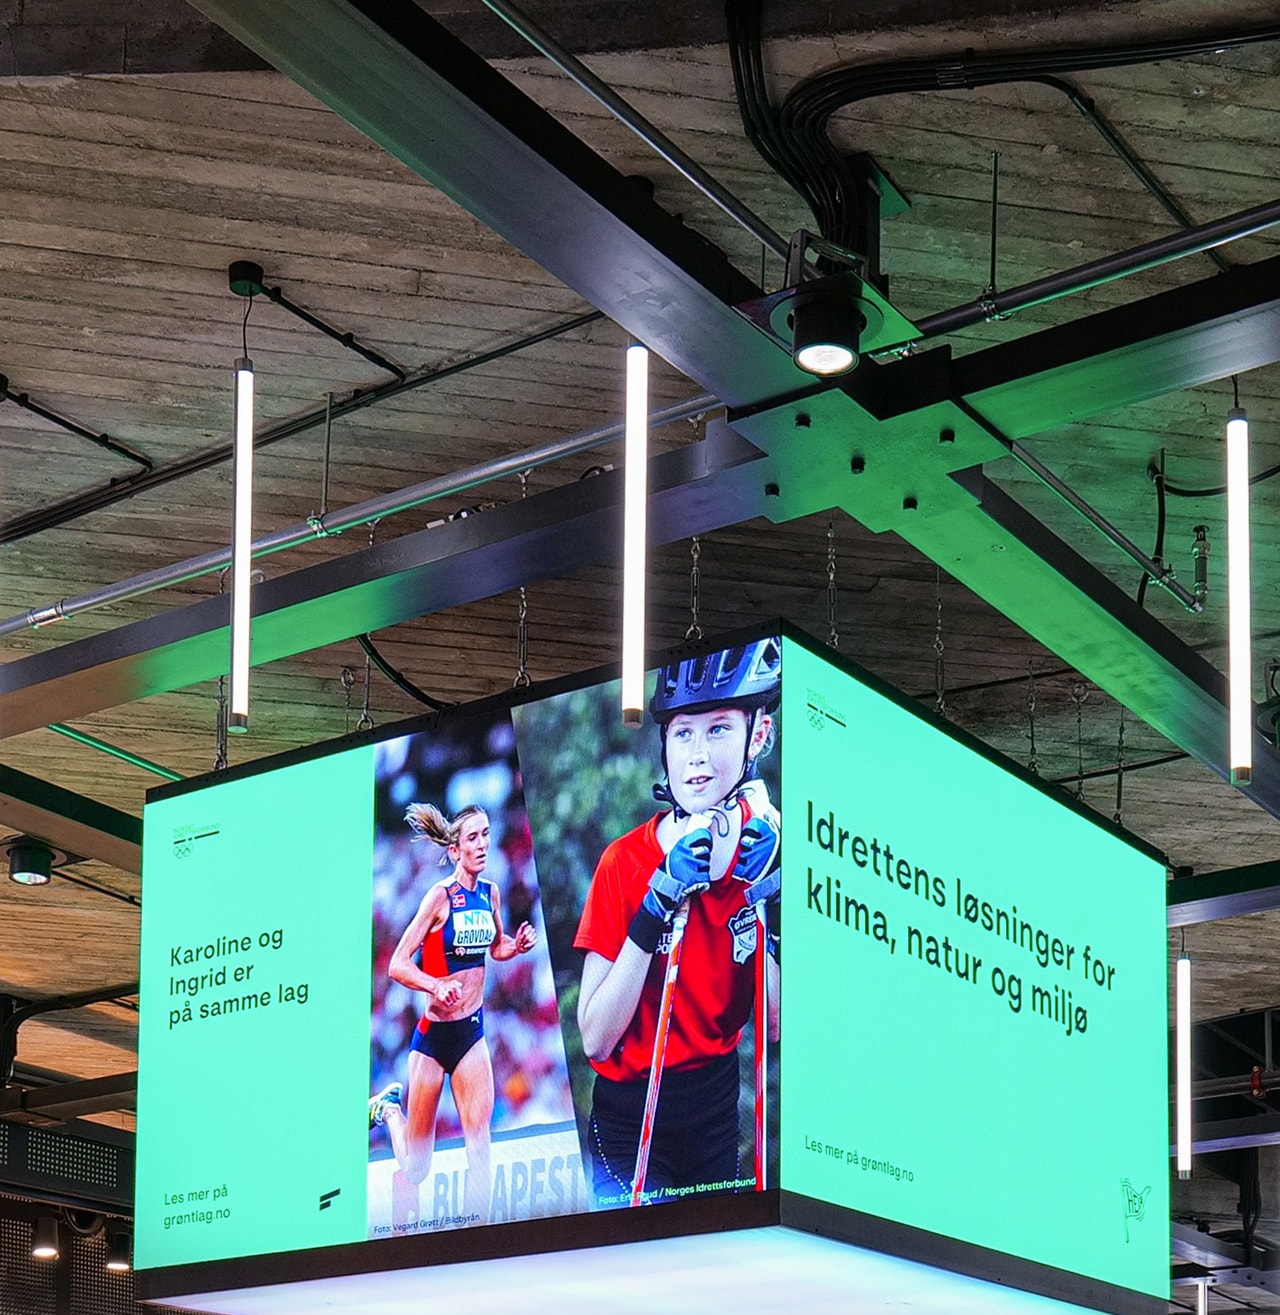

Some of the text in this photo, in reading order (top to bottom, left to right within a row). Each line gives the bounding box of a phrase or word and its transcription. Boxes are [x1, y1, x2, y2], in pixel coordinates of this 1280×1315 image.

[807, 800, 1116, 991] Idrettens løsninger for
[170, 928, 284, 967] Karoline og
[807, 867, 1088, 1037] klima, natur og miljø
[170, 964, 254, 996] Ingrid er
[169, 983, 309, 1030] på samme lag
[805, 1135, 914, 1182] Les mer på grøntlag.no
[164, 1183, 228, 1206] Les mer på
[665, 1186, 694, 1197] Norges
[695, 1177, 756, 1193] Idrettsforbund
[163, 1207, 231, 1230] grøntlag.no
[393, 1221, 418, 1232] Vegard
